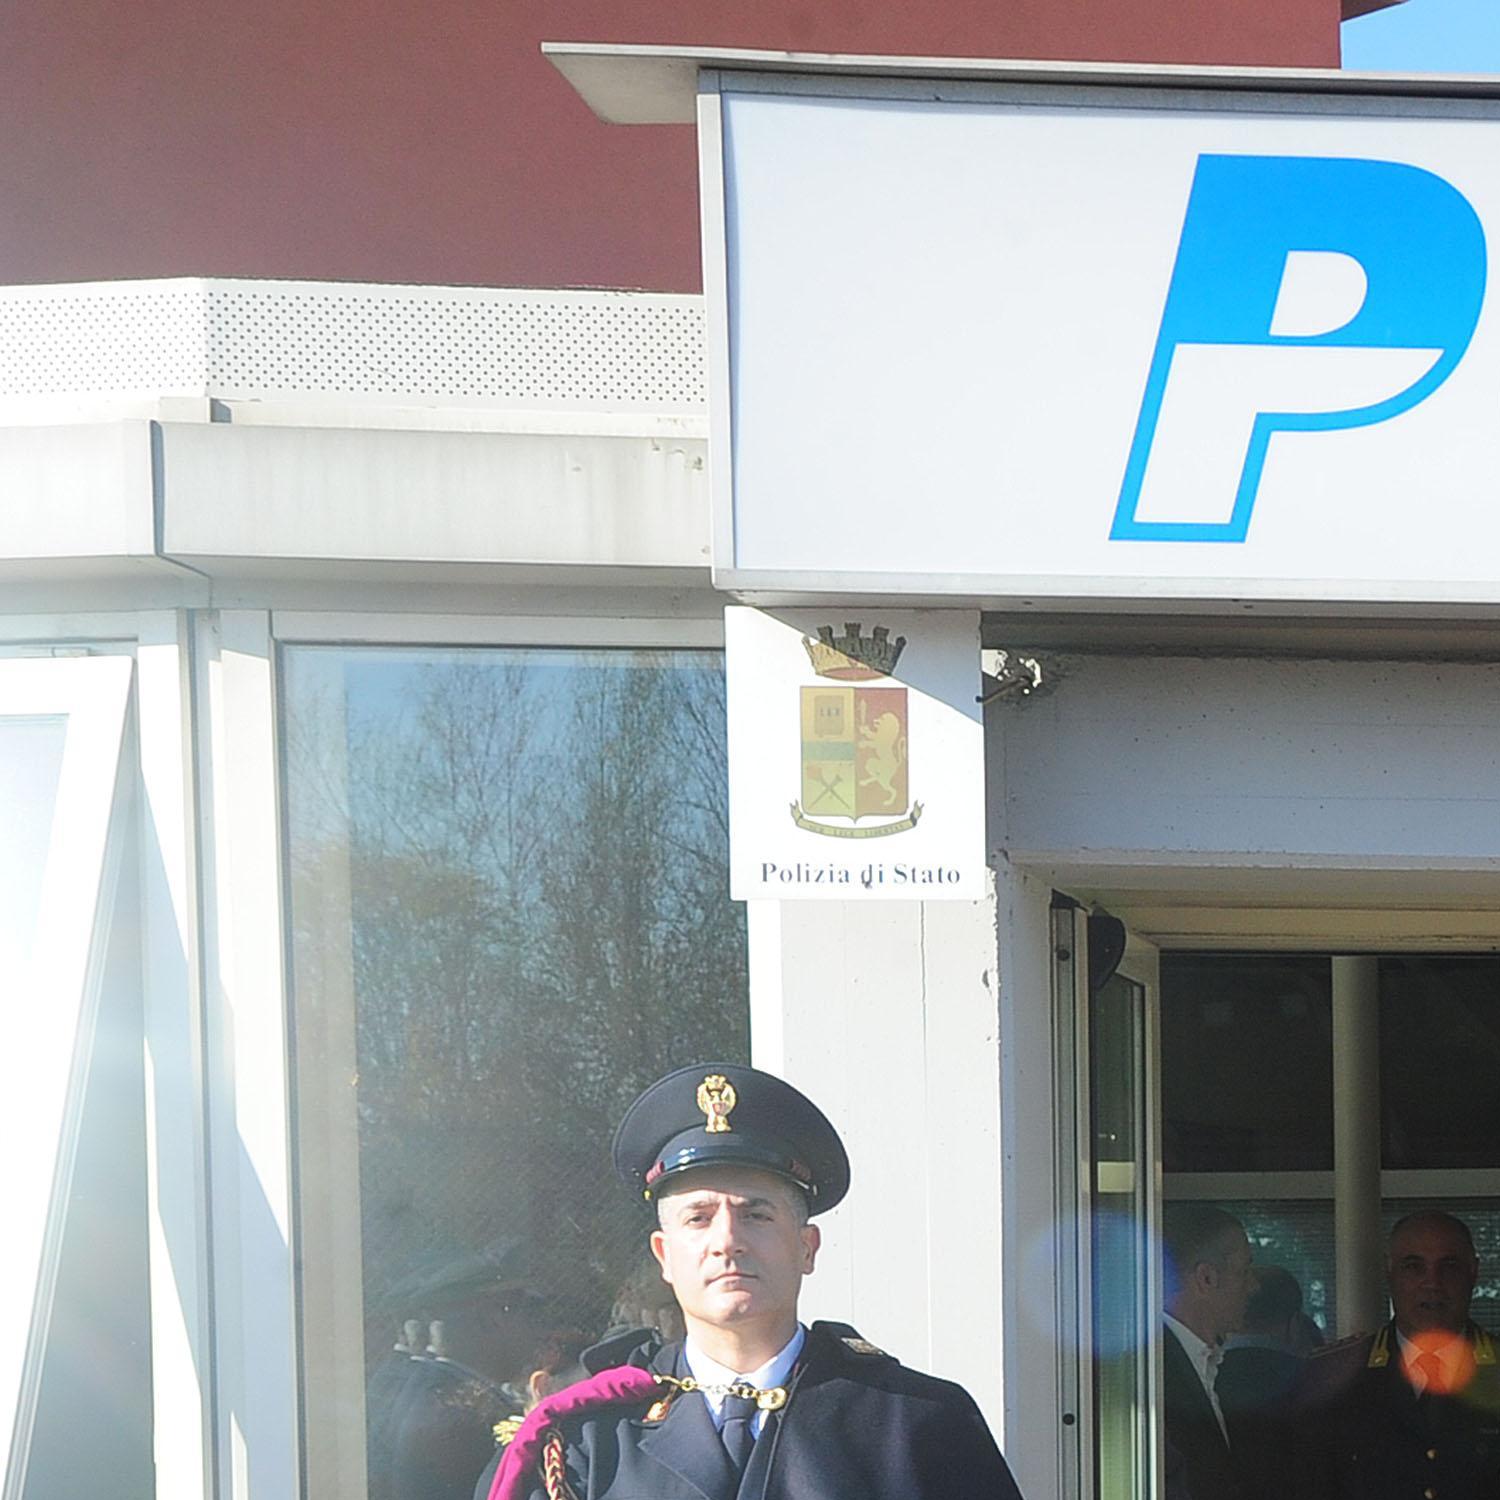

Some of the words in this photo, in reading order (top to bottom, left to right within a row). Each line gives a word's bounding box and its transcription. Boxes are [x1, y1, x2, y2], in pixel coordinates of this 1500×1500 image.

[761, 862, 850, 884] Polizia
[861, 863, 884, 886] di
[893, 862, 961, 885] Stato
